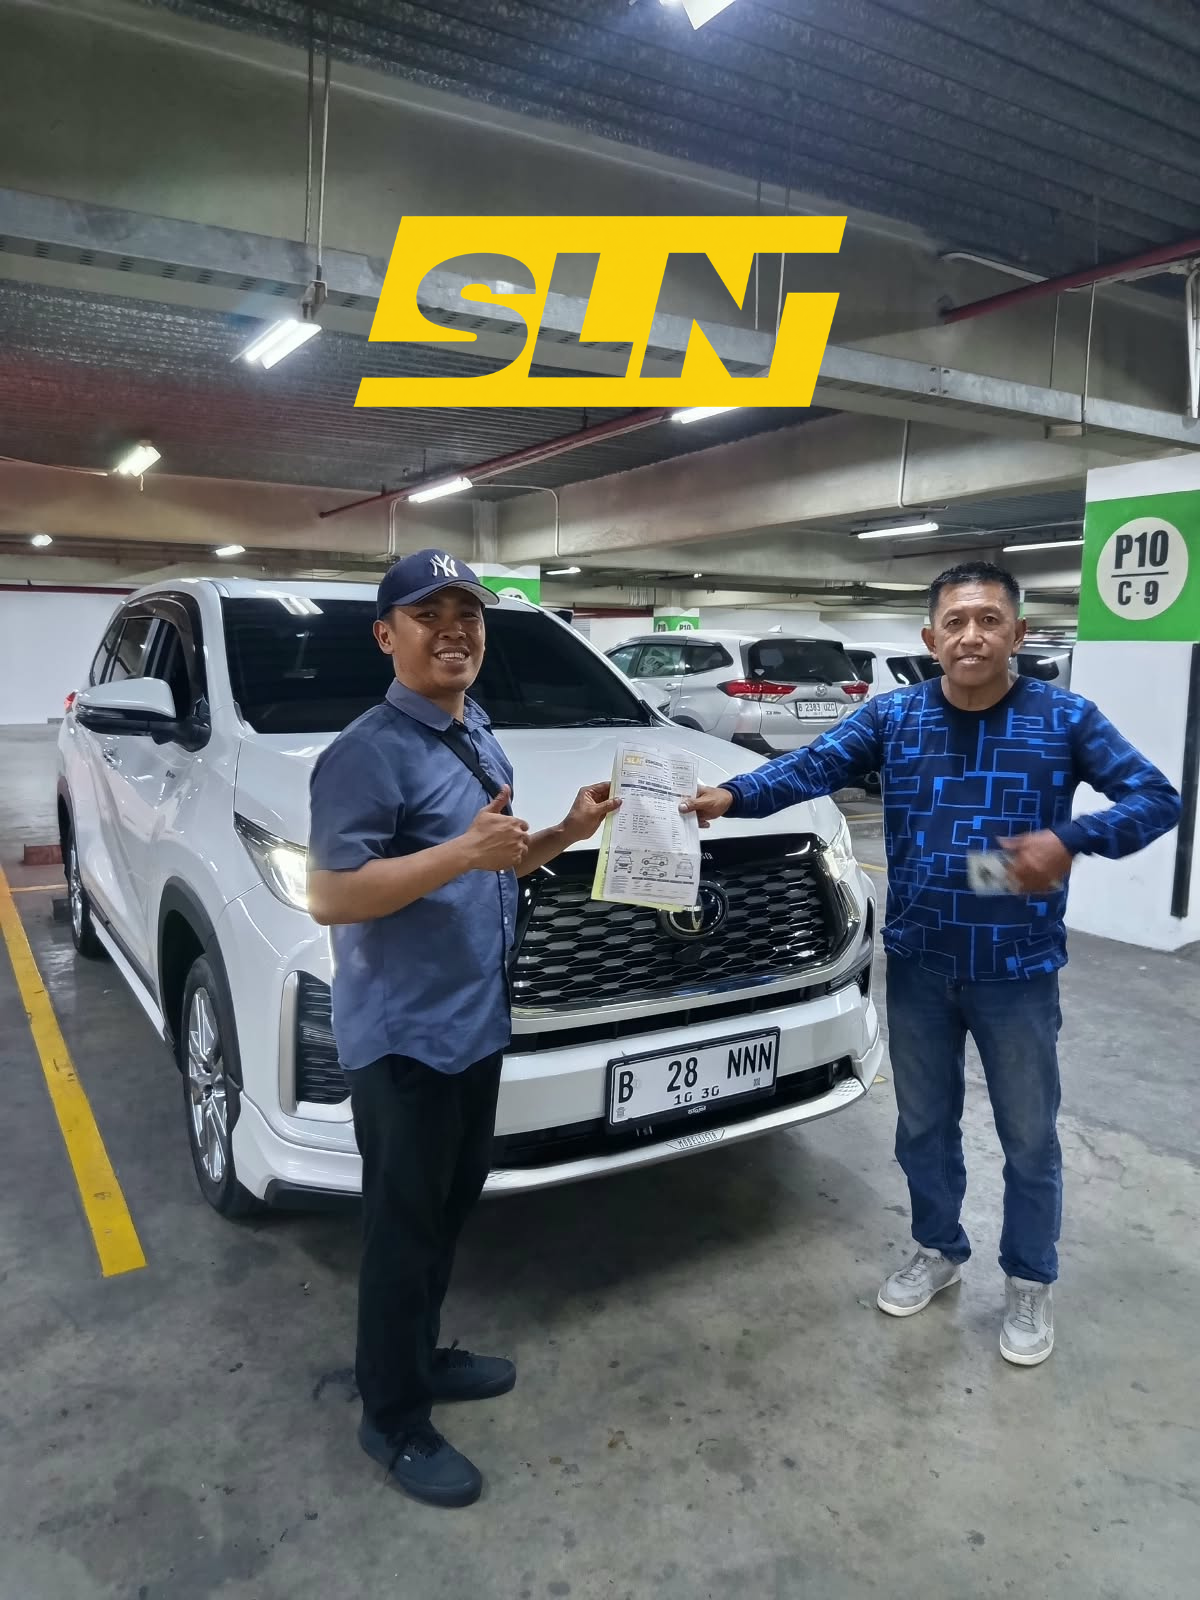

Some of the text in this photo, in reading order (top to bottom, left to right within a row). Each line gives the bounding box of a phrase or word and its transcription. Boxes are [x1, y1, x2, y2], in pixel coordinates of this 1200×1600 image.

[429, 554, 459, 577] NY
[1114, 529, 1169, 570] P10
[618, 1040, 773, 1104] B 28 NNN
